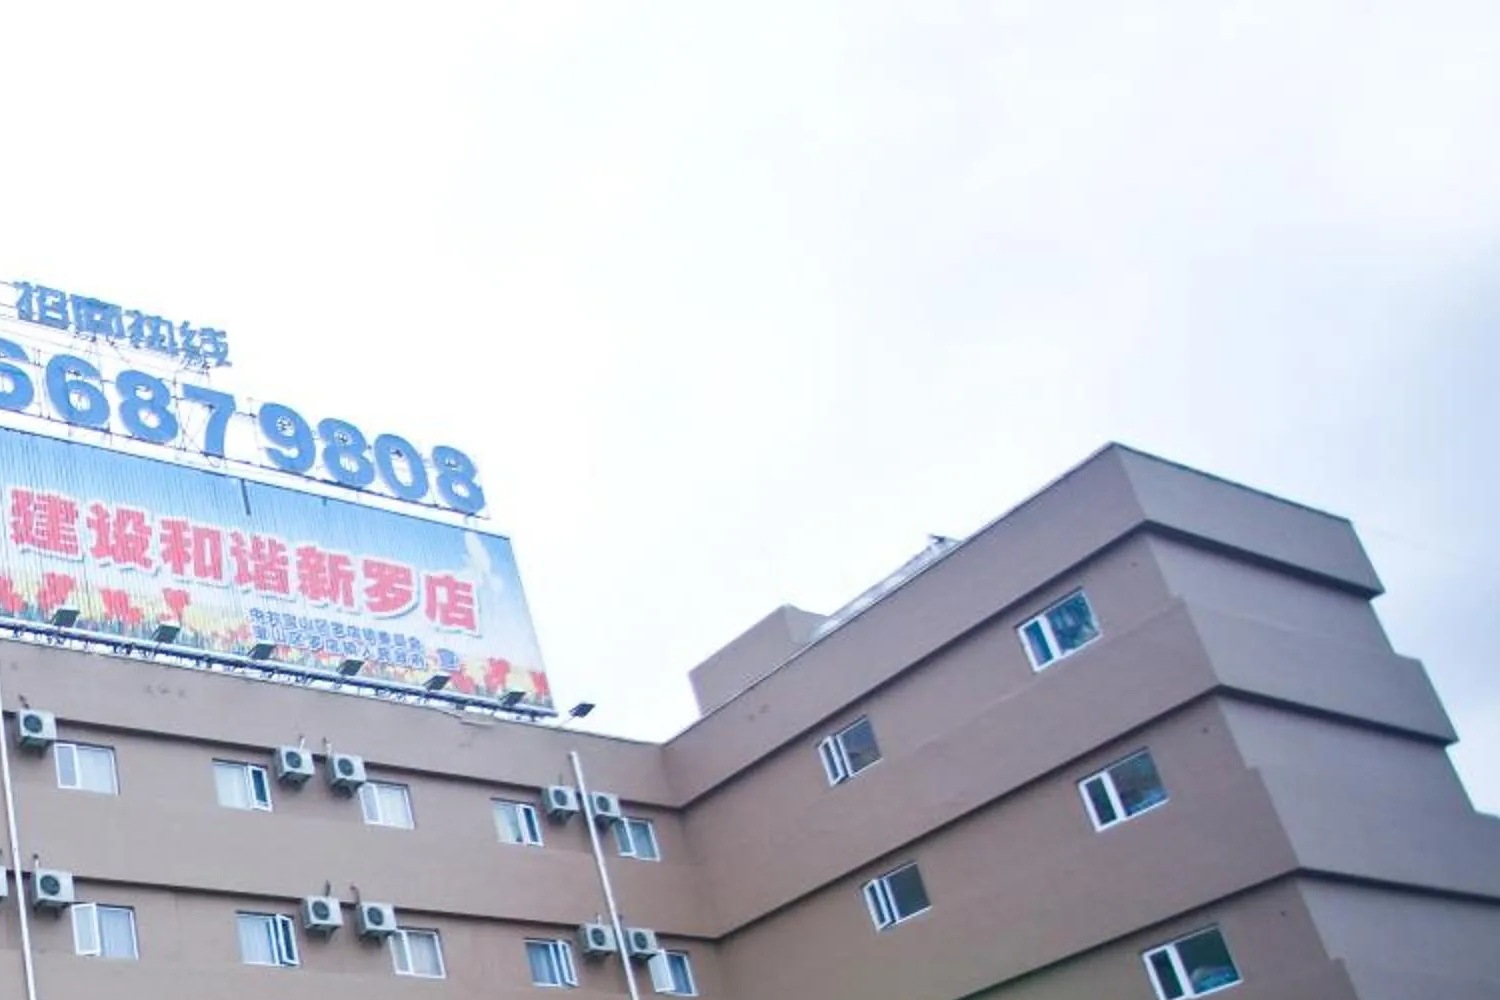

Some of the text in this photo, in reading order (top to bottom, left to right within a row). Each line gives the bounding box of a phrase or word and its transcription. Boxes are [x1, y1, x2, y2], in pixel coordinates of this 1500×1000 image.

[8, 487, 479, 632] 建设和谐新罗店
